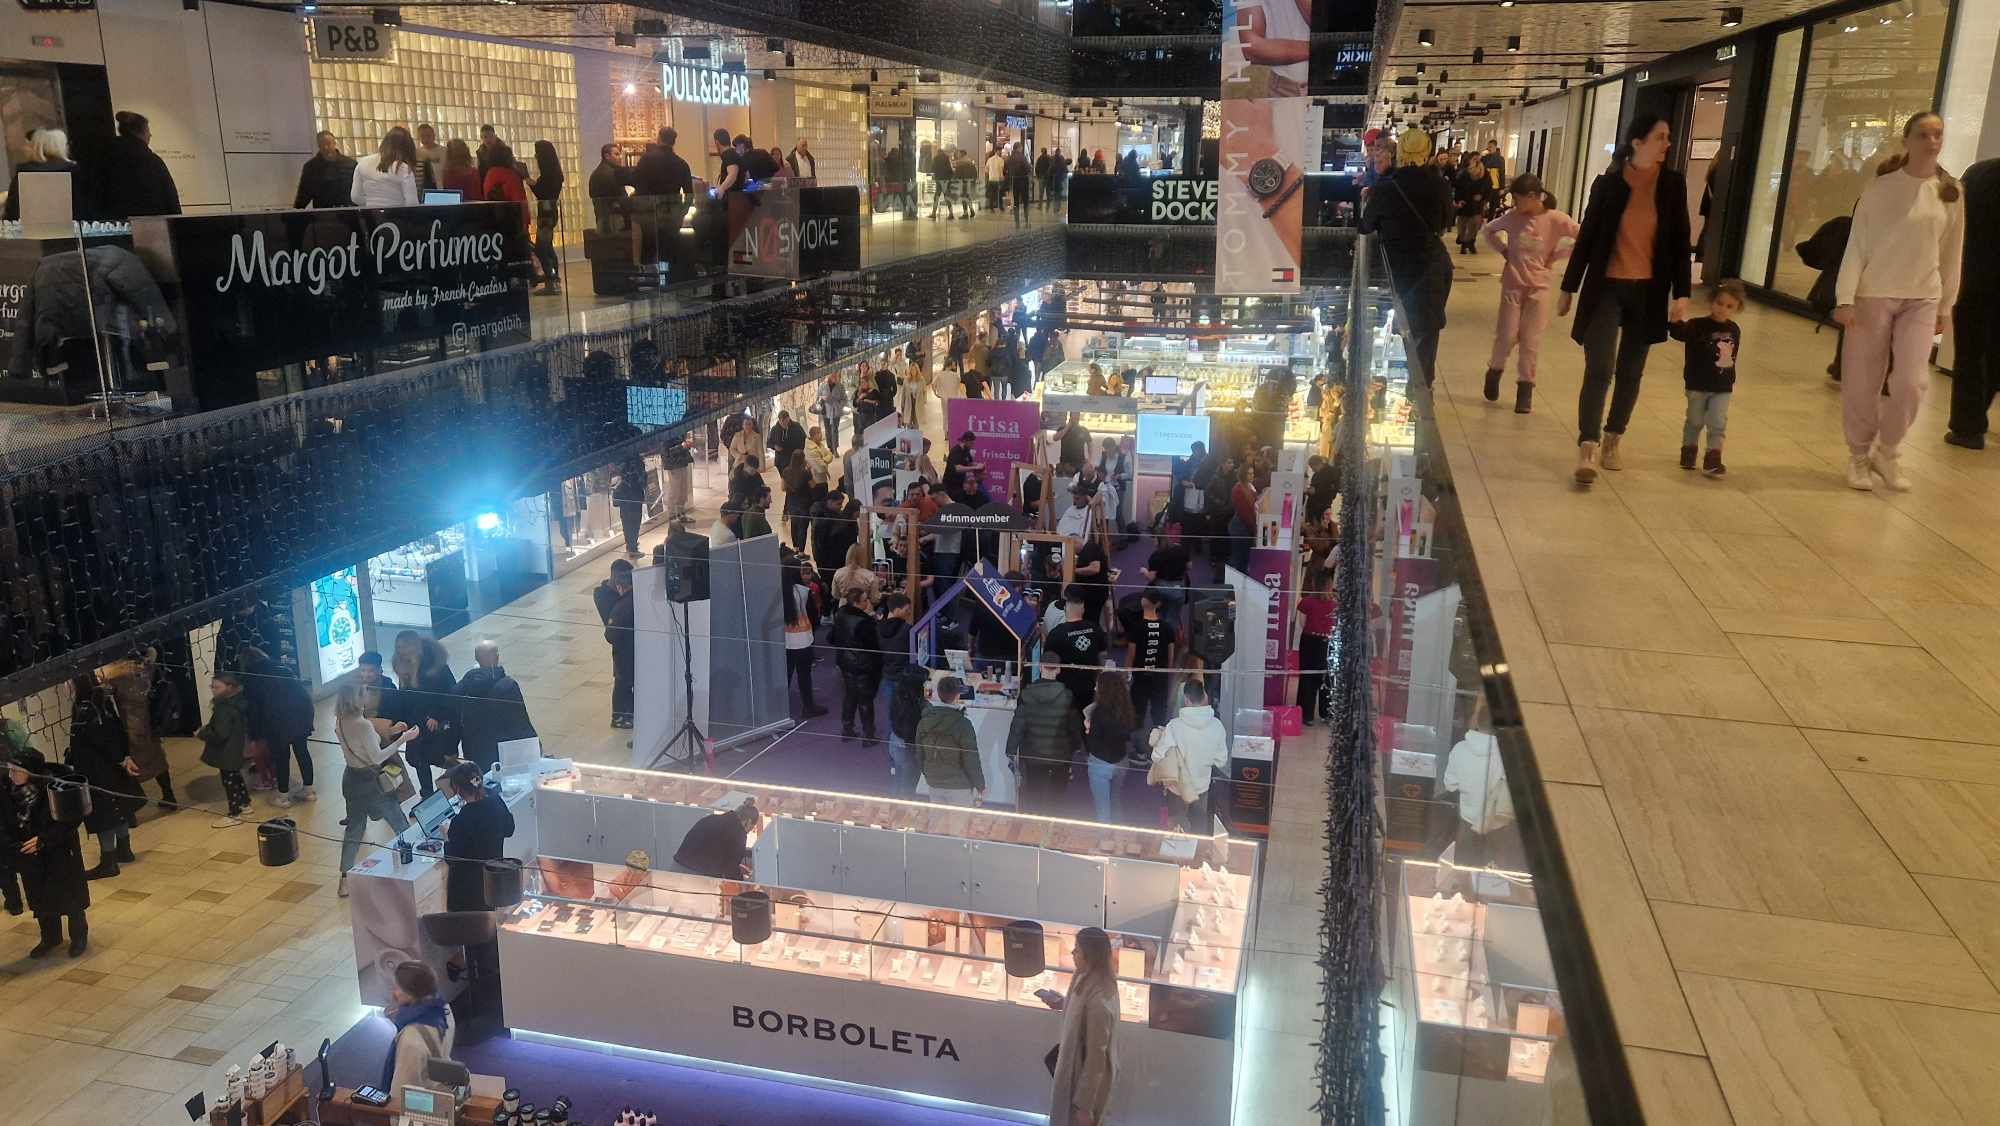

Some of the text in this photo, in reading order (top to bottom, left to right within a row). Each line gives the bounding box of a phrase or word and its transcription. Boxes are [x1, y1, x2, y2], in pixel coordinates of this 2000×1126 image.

[328, 25, 379, 52] P&B
[662, 63, 750, 106] PULL&BEAR
[1222, 0, 1253, 285] TOMMY HIL
[1152, 180, 1218, 199] STEVE
[1152, 201, 1216, 220] DOCK
[216, 219, 504, 295] Margot Perfumes
[382, 276, 508, 311] made by French Creators
[470, 313, 522, 338] margotbih
[968, 415, 1019, 434] frisa
[870, 456, 890, 469] RAUN
[940, 513, 1010, 524] #dmmovember
[733, 1005, 960, 1062] BORBOLETA
